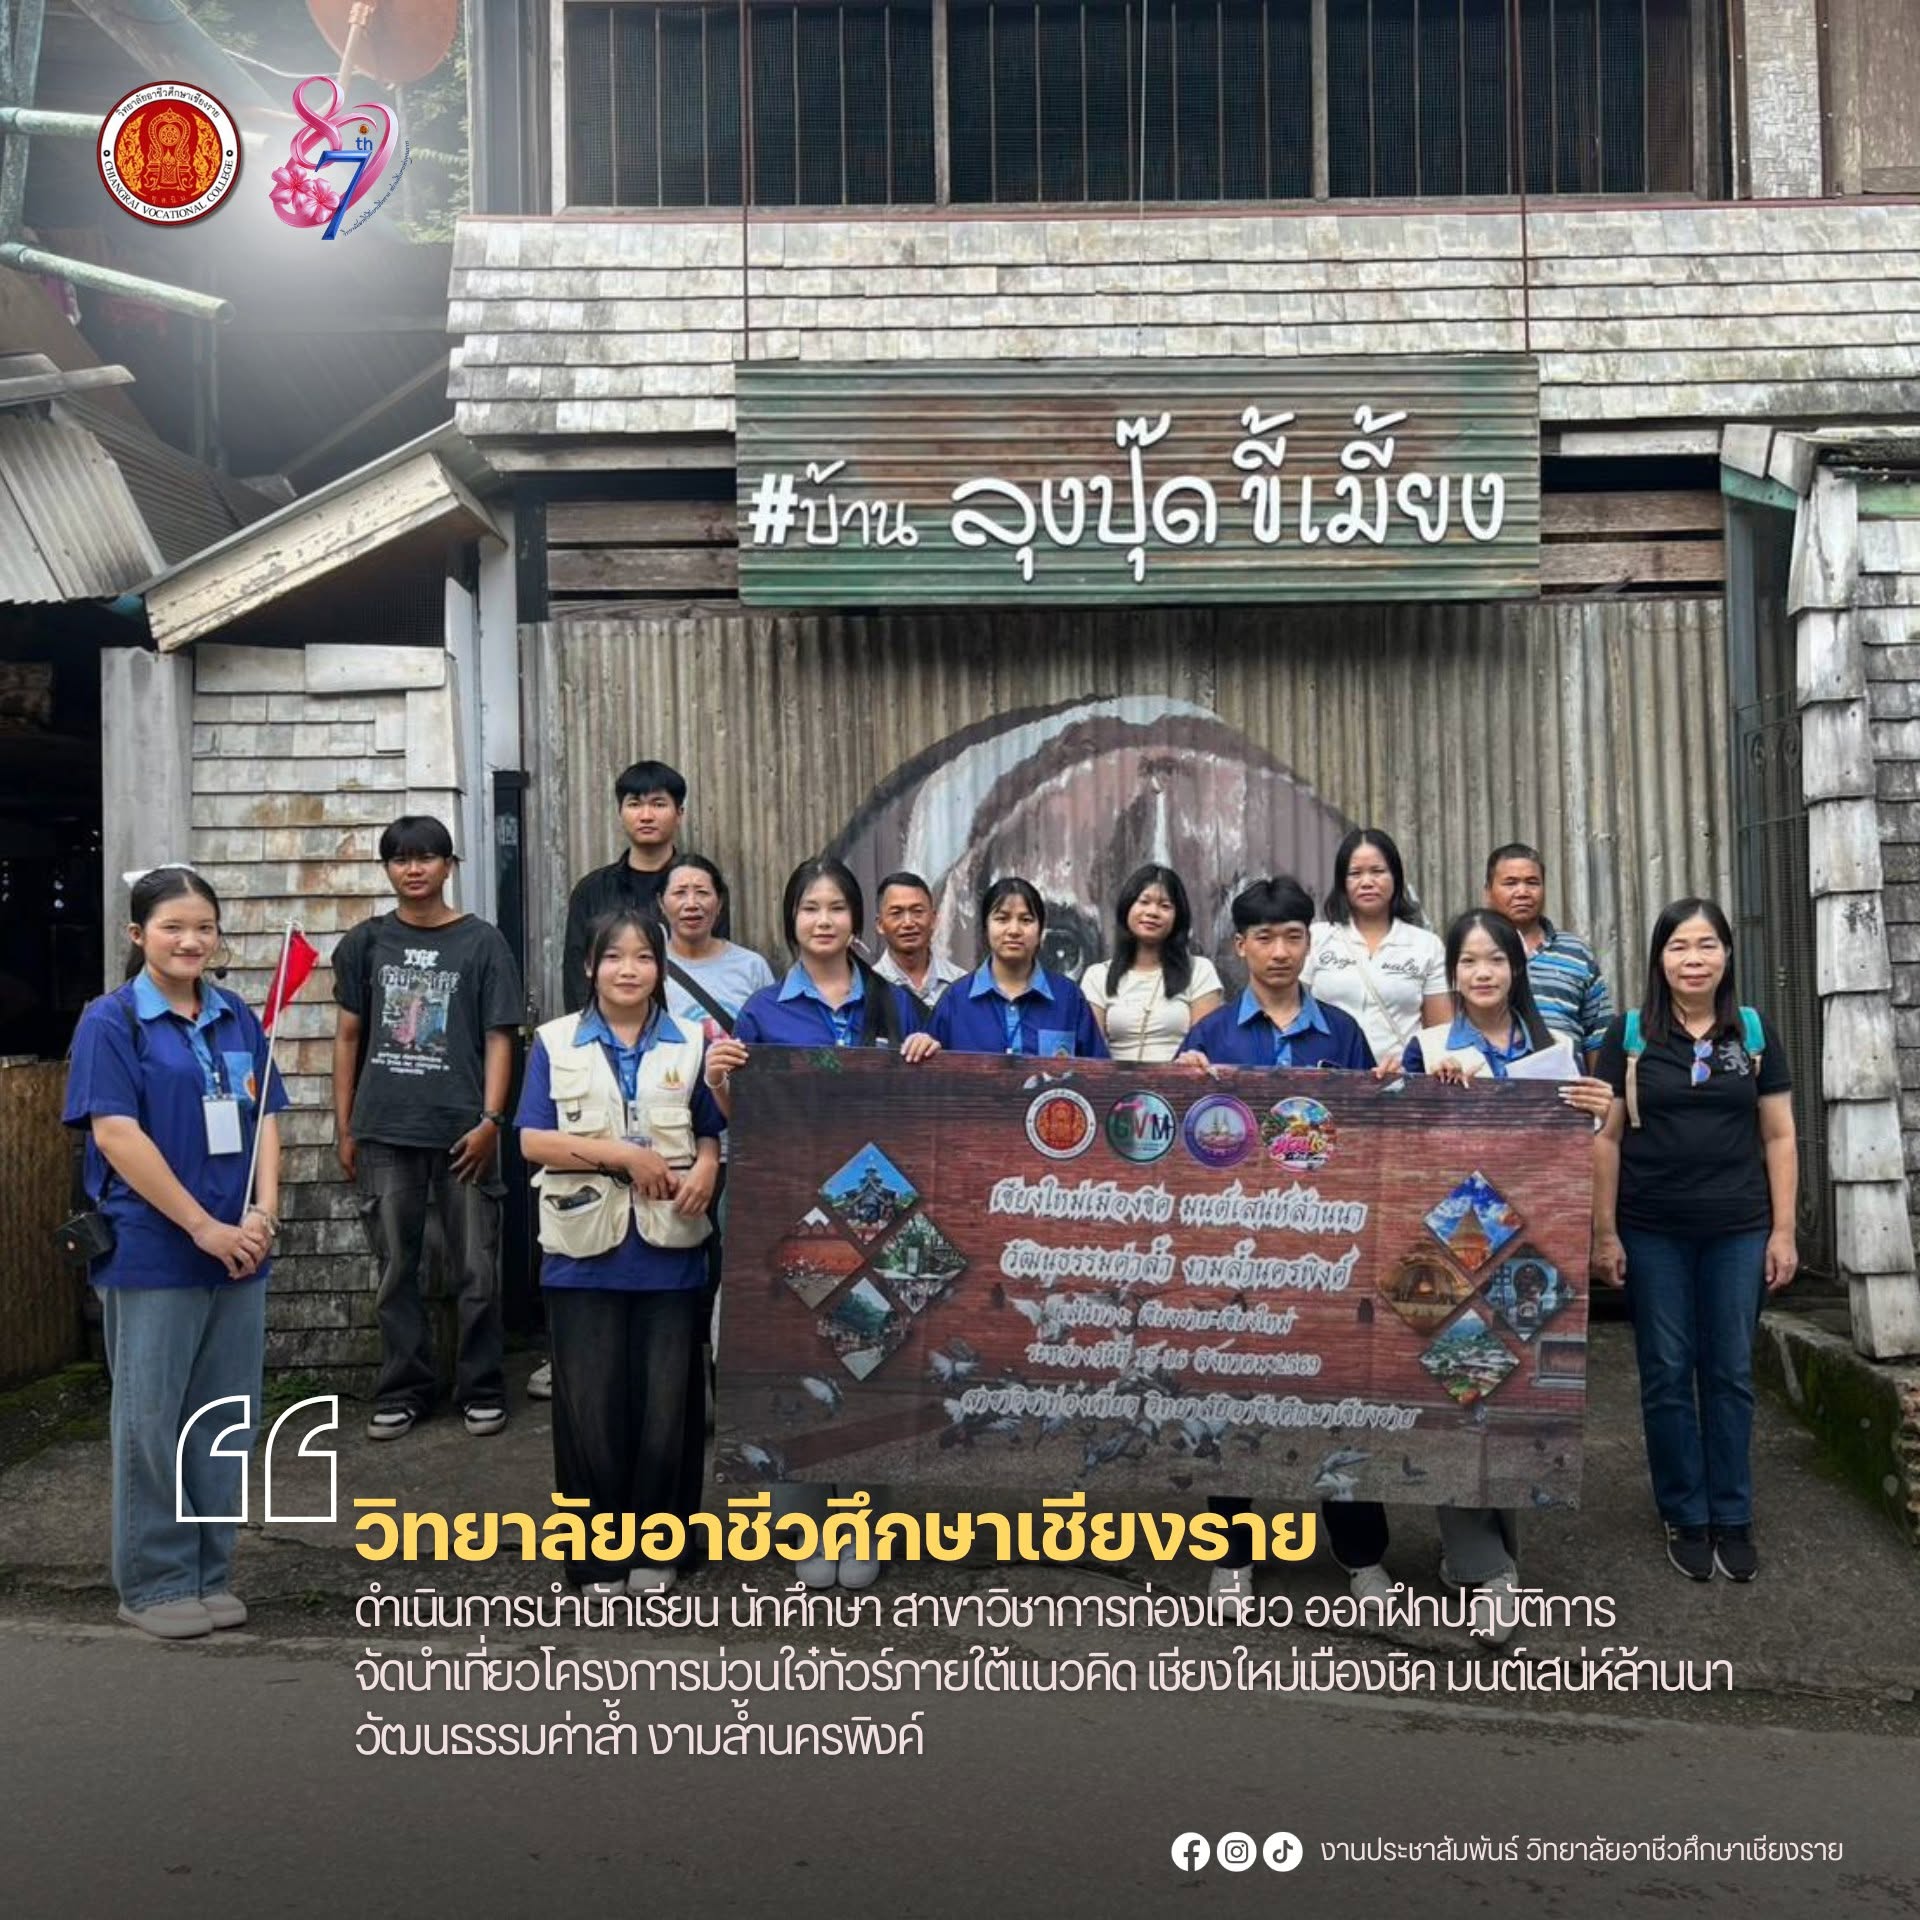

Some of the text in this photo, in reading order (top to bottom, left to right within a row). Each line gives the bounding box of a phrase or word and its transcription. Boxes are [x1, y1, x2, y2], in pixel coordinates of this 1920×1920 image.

[749, 405, 1506, 582] #บ้าน ลุงปุ๊ด ขี้เมี้ยง
[988, 1175, 1369, 1233] เชียงใหม่เมืองชิค มนต์เสน่ห์ล้านนา
[1000, 1235, 1361, 1291] วัฒนธรรมค่าล้ำ งามล้ำนครพิงค์
